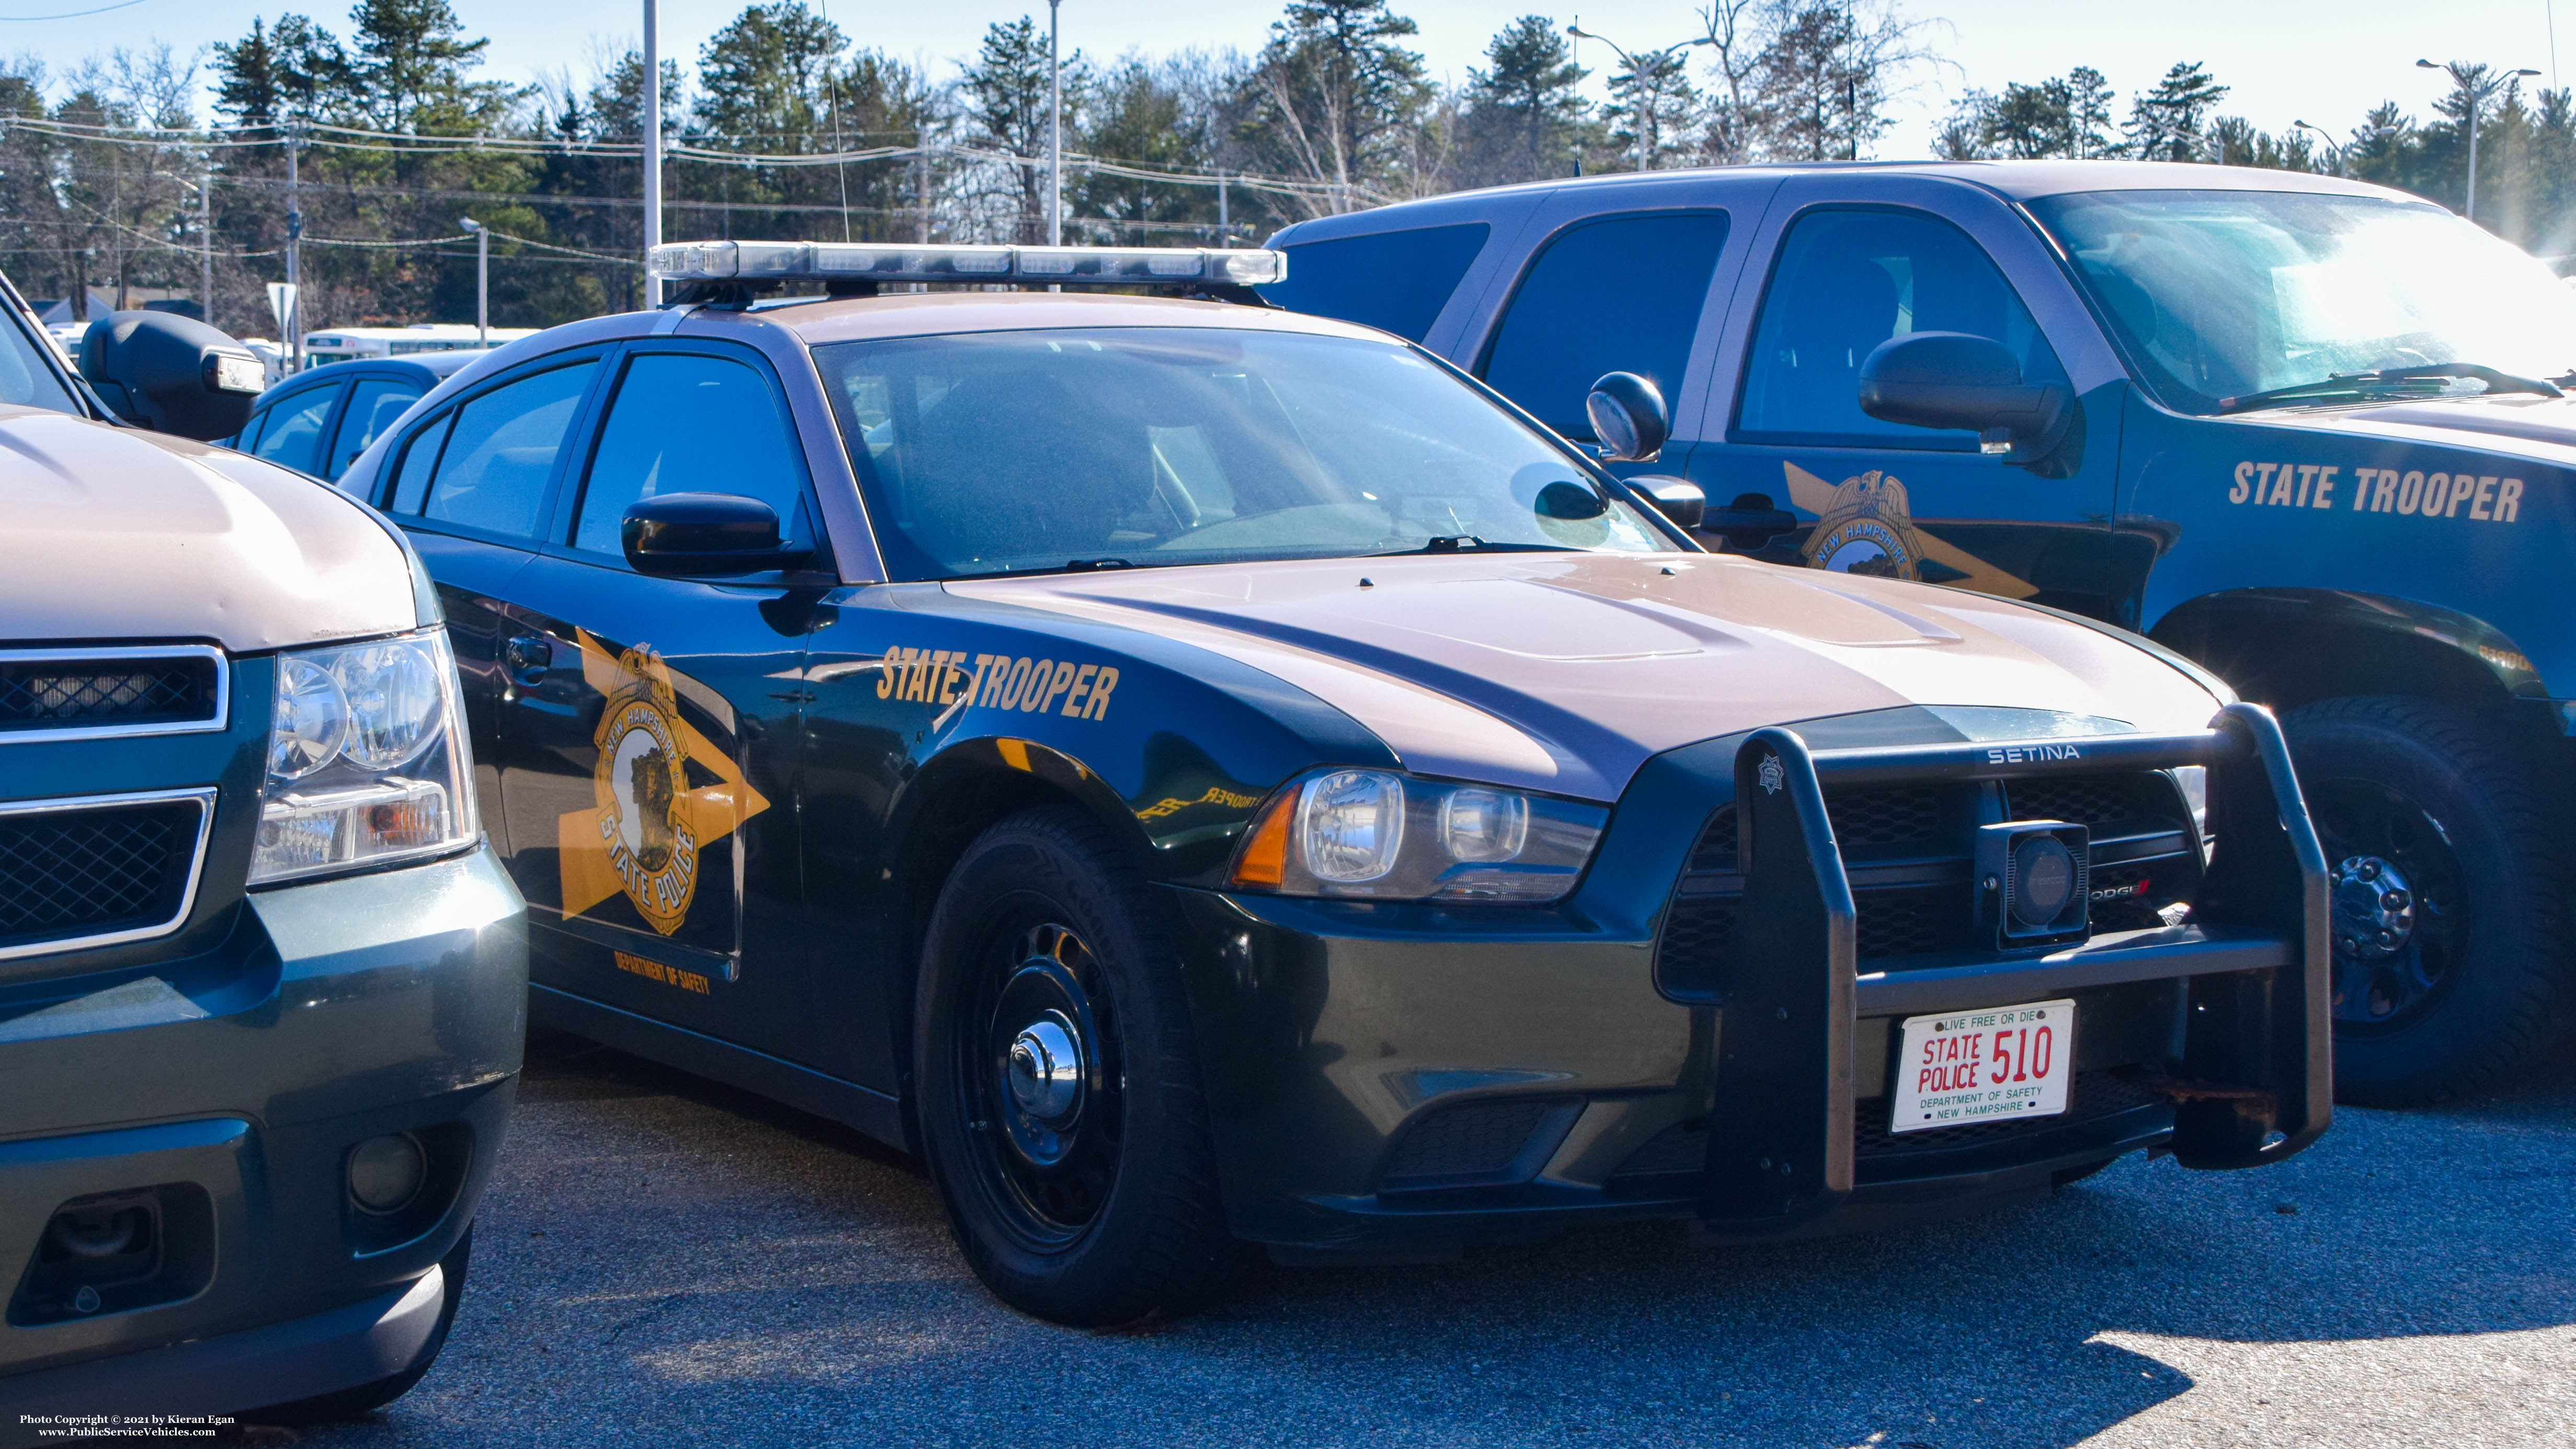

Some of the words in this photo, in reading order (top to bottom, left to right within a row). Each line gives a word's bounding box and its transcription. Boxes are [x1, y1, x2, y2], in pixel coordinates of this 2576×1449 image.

[2229, 461, 2339, 509] STATE
[2353, 468, 2523, 523] TROOPER
[1816, 532, 1841, 563] NEW
[1846, 523, 1907, 567] HAMPSHIRE
[877, 645, 967, 705] STATE
[967, 653, 1119, 721] TROOPER
[607, 718, 624, 755] NEW
[627, 707, 676, 766] HAMPSHIRE
[1987, 745, 2080, 764] SETINA
[601, 813, 651, 908] STATE
[654, 823, 695, 913] POLICE
[2090, 886, 2140, 900] ODGE
[614, 950, 666, 983] DEPARTMENT
[666, 966, 677, 986] OF
[678, 969, 710, 996] SAFETY
[1945, 1018, 1965, 1031] LIVE
[1971, 1015, 1995, 1028] FREE
[2001, 1012, 2014, 1024] OR
[2020, 1010, 2035, 1022] DIE
[1923, 1033, 1983, 1065] STATE
[1991, 1026, 2052, 1084] 510
[1918, 1061, 1980, 1094] POLICE
[1920, 1093, 1983, 1109] DEPARTMENT
[1988, 1091, 2001, 1101] OF
[2006, 1086, 2043, 1099] SAFETY
[1937, 1108, 1959, 1119] NEW
[1965, 1101, 2023, 1116] HAMPSHIRE
